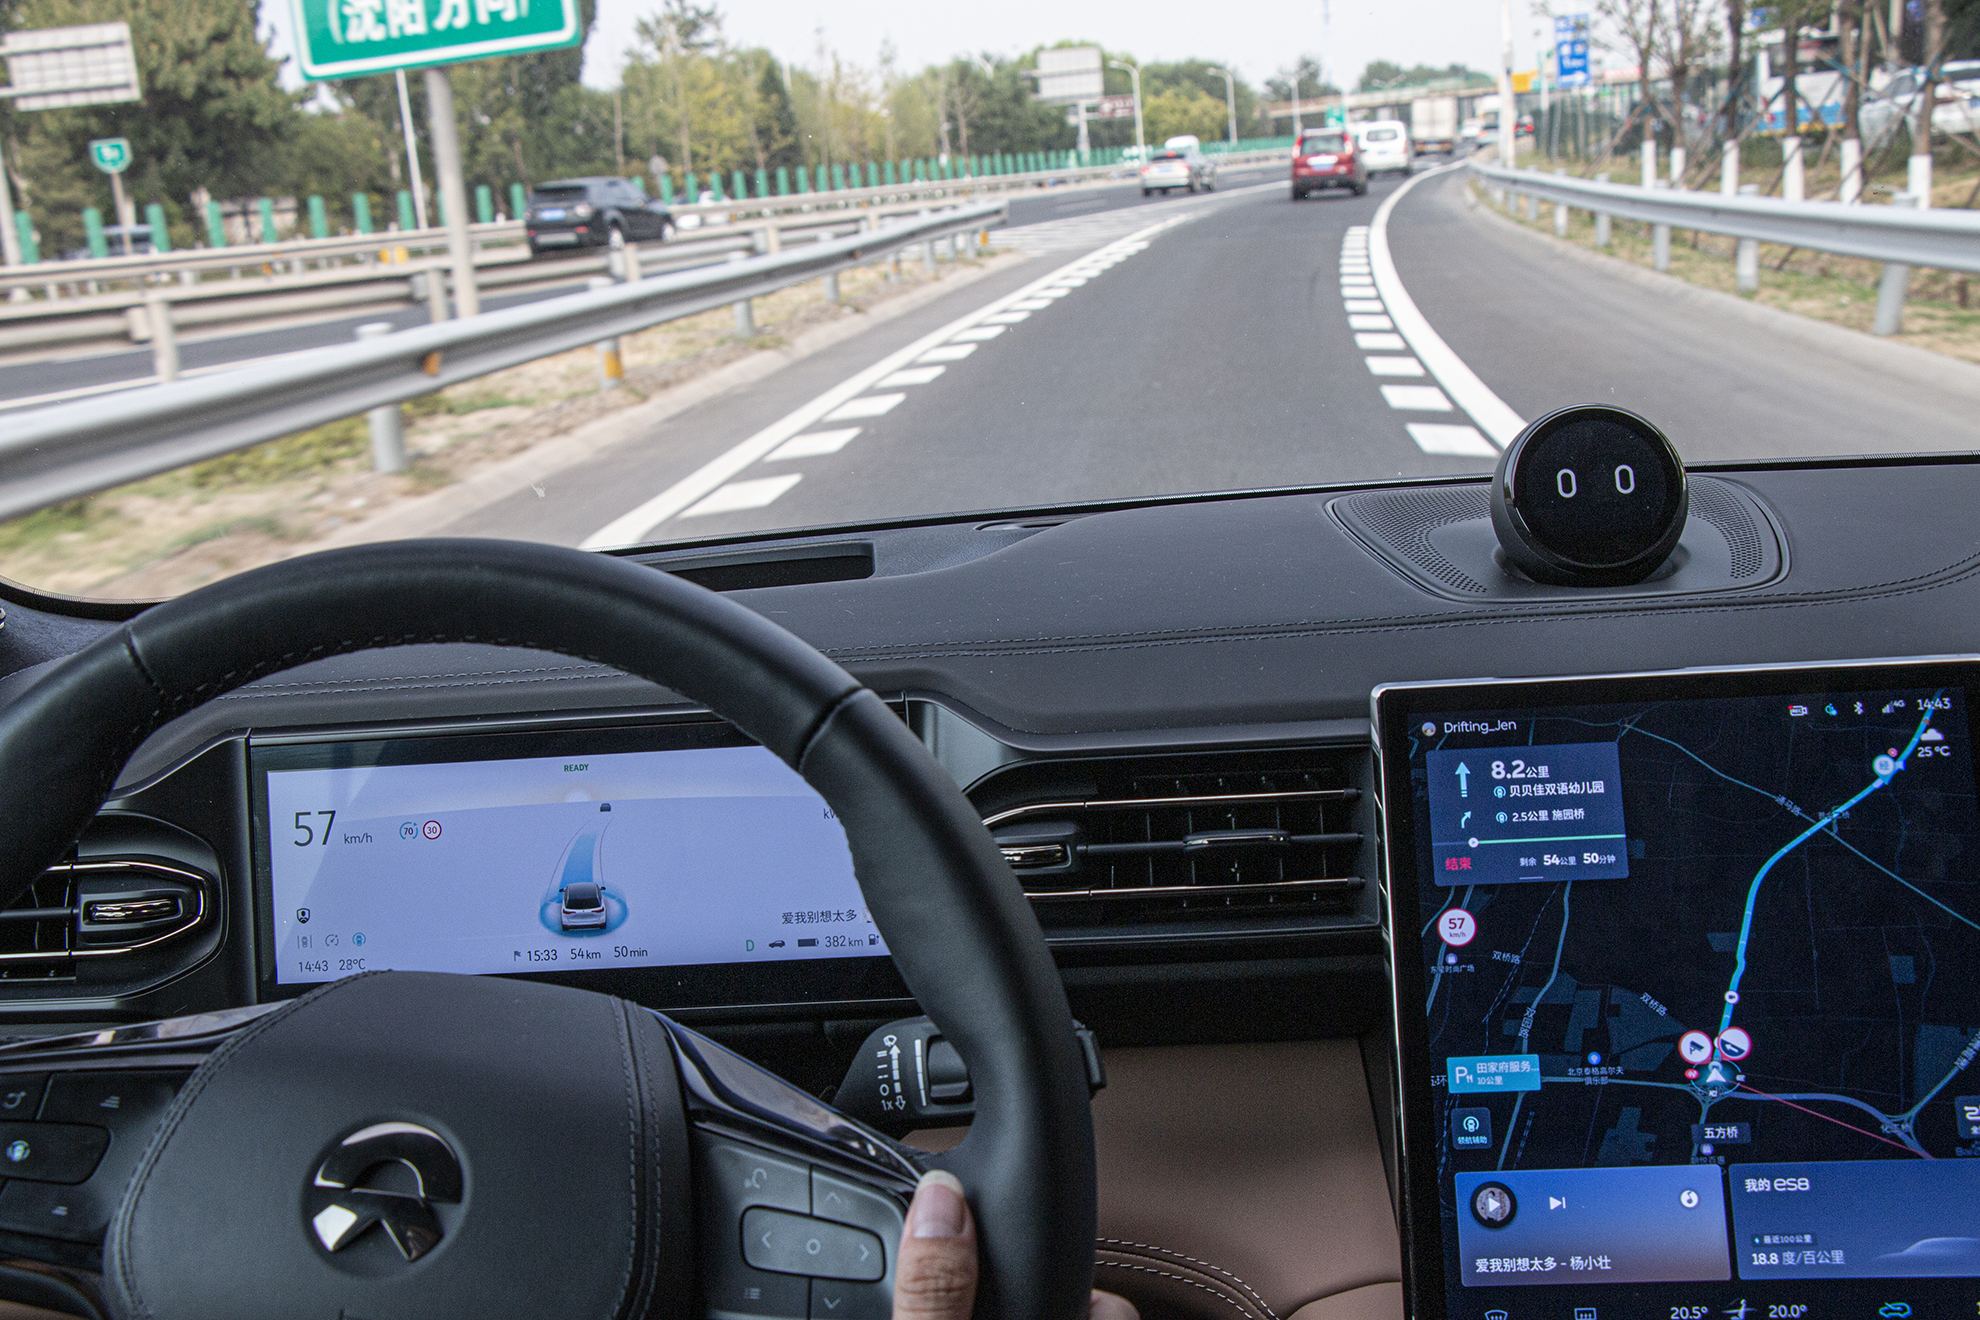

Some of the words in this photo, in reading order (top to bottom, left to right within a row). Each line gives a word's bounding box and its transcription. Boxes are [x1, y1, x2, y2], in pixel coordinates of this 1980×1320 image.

[1893, 699, 1906, 708] 4G
[1917, 697, 1952, 711] 14:43
[1443, 719, 1517, 735] Drifting_Jen
[563, 763, 589, 772] READY
[1509, 780, 1605, 798] 贝贝佳双语幼儿园
[1512, 809, 1550, 823] 2.5公里
[1552, 808, 1586, 821] 施园桥
[293, 810, 337, 847] 57
[343, 832, 373, 845] km/h
[403, 826, 414, 836] 70
[426, 826, 438, 835] 30
[1444, 856, 1472, 871] 结束
[1519, 856, 1538, 867] 剩余
[781, 908, 858, 925] 爱我别想太多
[1448, 917, 1466, 930] 57
[1449, 930, 1467, 938] km/h
[745, 939, 755, 952] D
[527, 949, 558, 962] 15:33
[298, 960, 329, 972] 14:43
[1477, 1075, 1504, 1086] 10公里
[1703, 1125, 1739, 1140] 五方桥
[1744, 1177, 1771, 1193] 我的
[1763, 1234, 1813, 1245] 最近100公里
[1475, 1256, 1558, 1273] 爱我别想太多
[1569, 1255, 1612, 1271] 杨小壮
[1752, 1253, 1779, 1266] 18.8
[1782, 1250, 1845, 1266] 度/百公里
